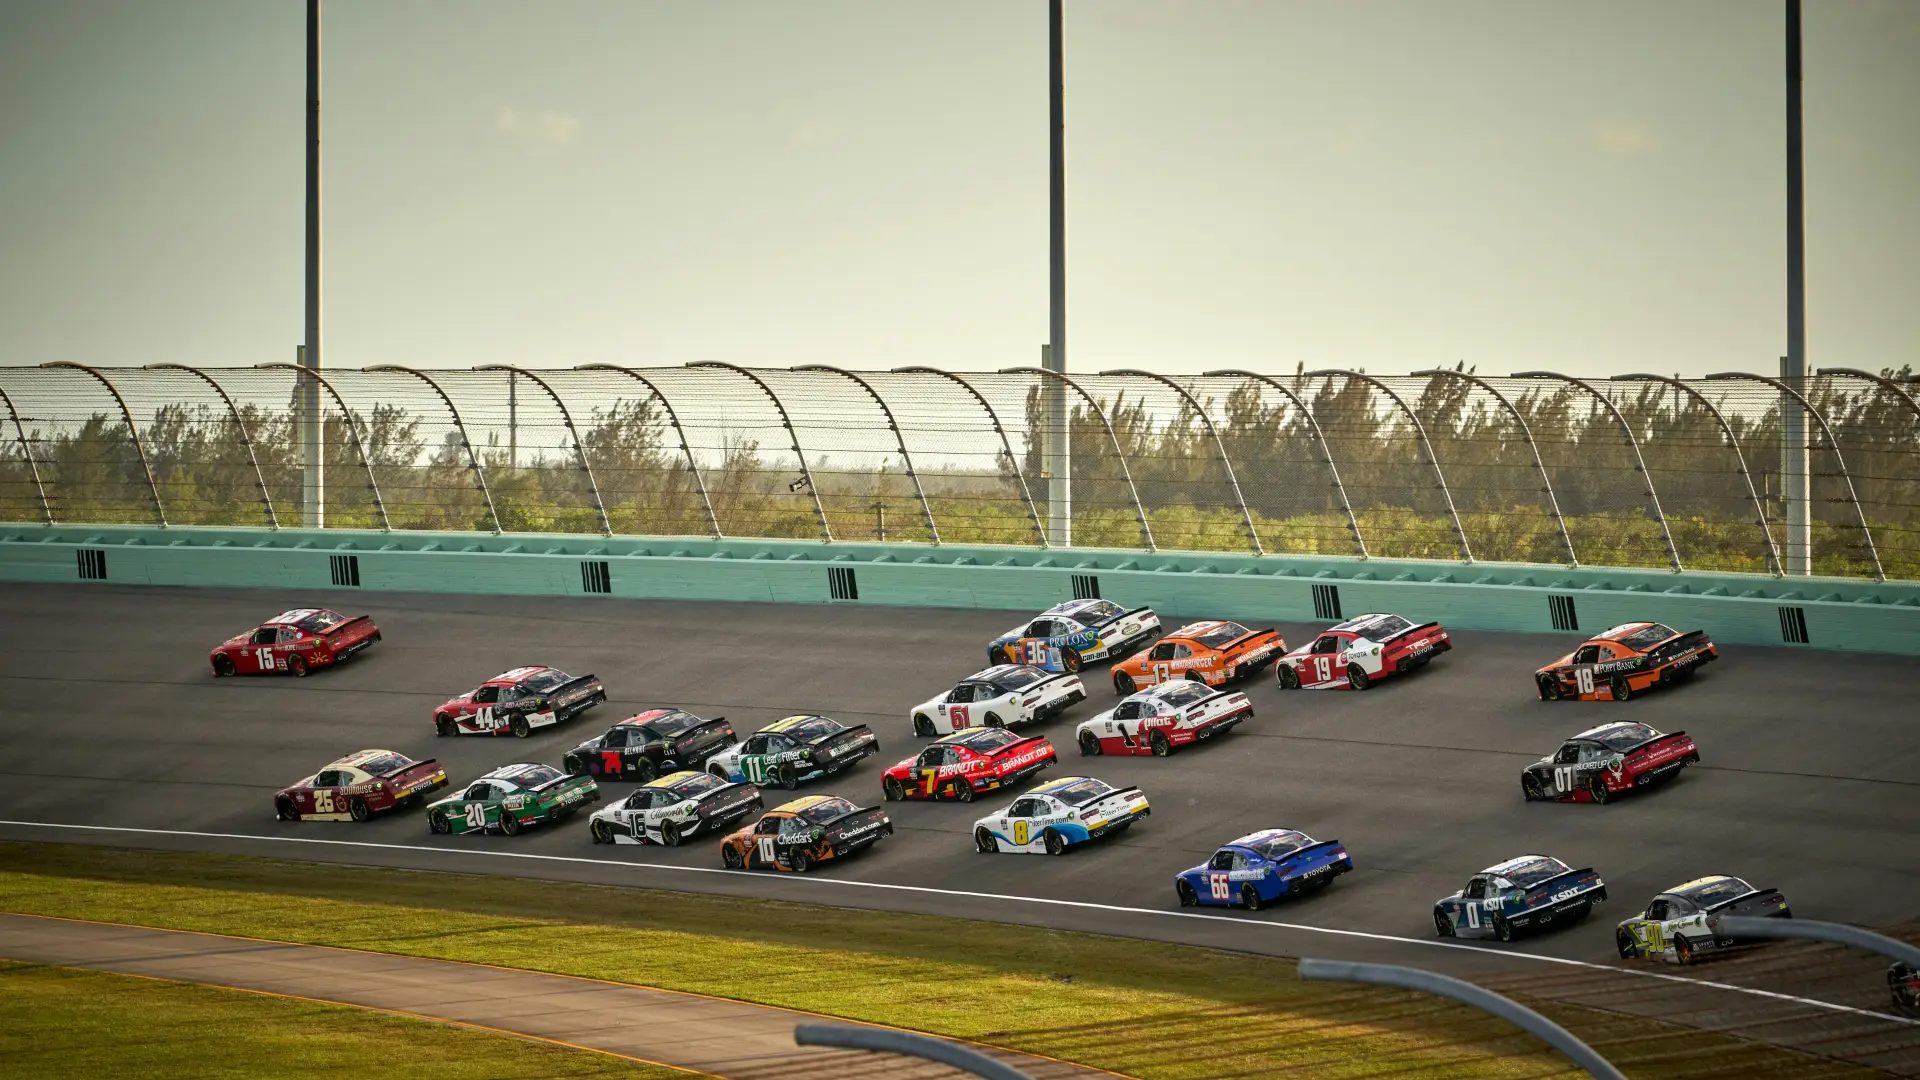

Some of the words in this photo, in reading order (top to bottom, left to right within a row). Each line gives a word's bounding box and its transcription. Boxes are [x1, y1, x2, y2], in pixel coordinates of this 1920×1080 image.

[255, 647, 275, 671] 15
[1026, 640, 1047, 665] 36
[1082, 650, 1107, 662] can-am
[1251, 651, 1272, 664] TOYOTA
[1348, 650, 1368, 661] TOYOTA
[1413, 644, 1434, 657] TOYOTA
[1677, 654, 1699, 667] TOYOTA
[1152, 663, 1171, 684] 13
[1313, 656, 1332, 682] 19
[1599, 662, 1617, 674] POPPY
[1616, 660, 1636, 671] BANK
[1574, 668, 1595, 694] 18
[1050, 694, 1071, 706] TOYOTA
[475, 706, 495, 731] 44
[949, 704, 971, 731] 61
[1144, 715, 1172, 731] pilot
[1117, 721, 1138, 749] 1
[602, 750, 622, 775] 74
[746, 755, 763, 783] 11
[938, 759, 981, 779] BRANDT
[1001, 747, 1047, 772] BRANDT.CO
[414, 780, 434, 792] TOYOTA
[921, 768, 937, 795] 7
[1554, 765, 1573, 794] 07
[313, 788, 336, 814] 26
[565, 793, 584, 806] TOYOTA
[464, 802, 487, 828] 20
[628, 810, 648, 838] 16
[777, 830, 813, 846] Cheddar's
[1013, 819, 1030, 846] 8
[757, 836, 776, 863] 10
[1308, 864, 1332, 878] TOYOTA
[1209, 872, 1231, 902] 66
[1549, 886, 1580, 904] KSDT
[1466, 901, 1481, 929] 0
[1482, 896, 1506, 912] KSDT
[1646, 924, 1665, 956] 90
